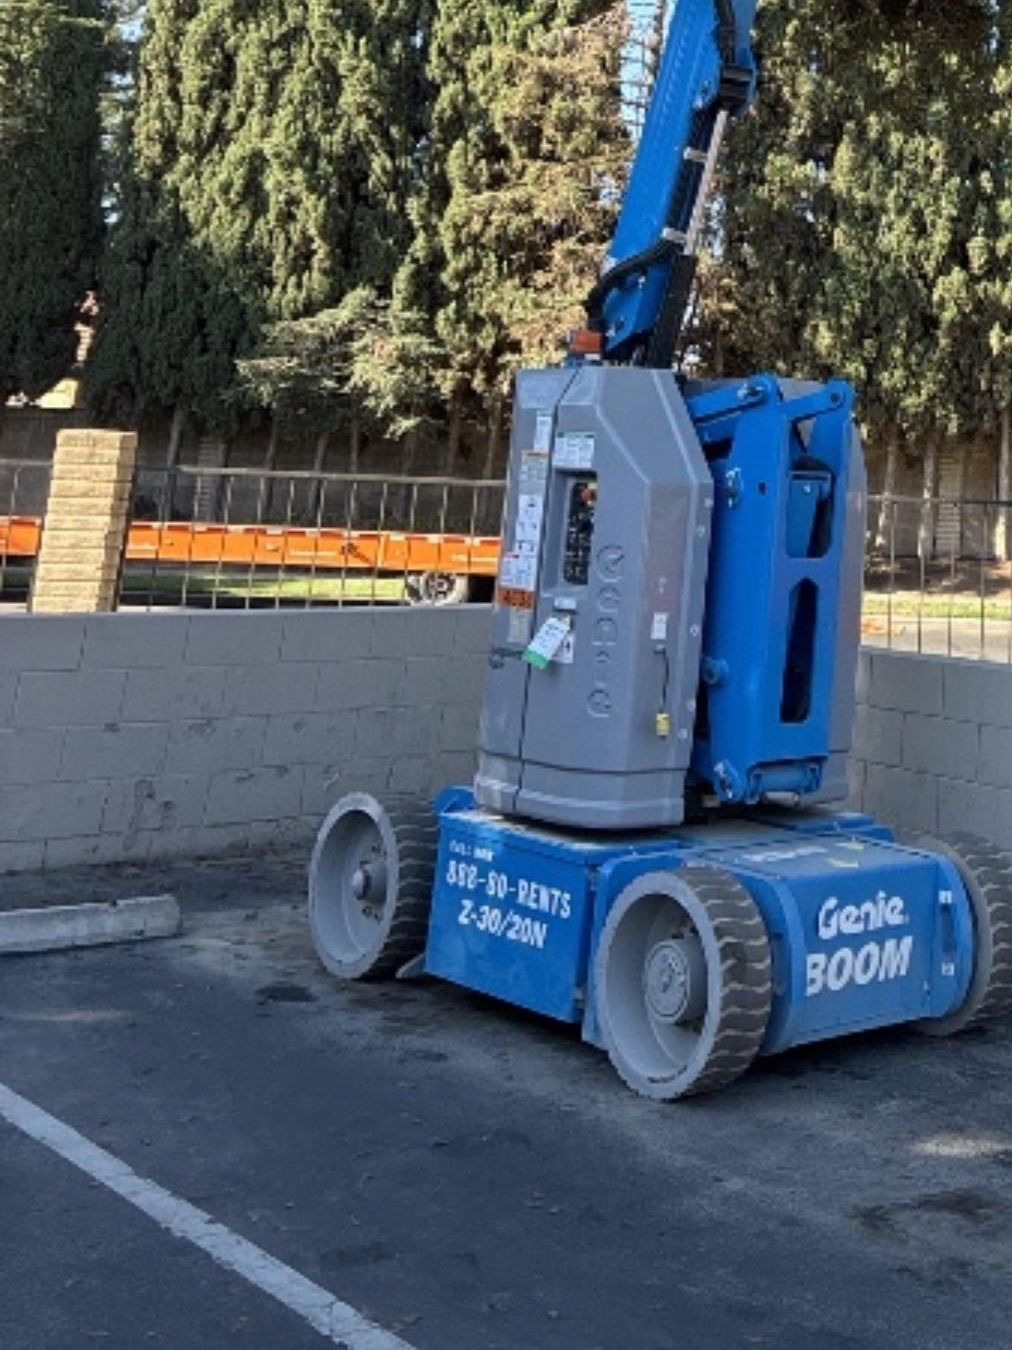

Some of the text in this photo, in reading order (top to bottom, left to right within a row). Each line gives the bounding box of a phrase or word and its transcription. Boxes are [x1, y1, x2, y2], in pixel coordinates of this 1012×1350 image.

[458, 899, 548, 949] Z-30/20N
[818, 890, 910, 940] Genie
[806, 935, 913, 997] BOOM
